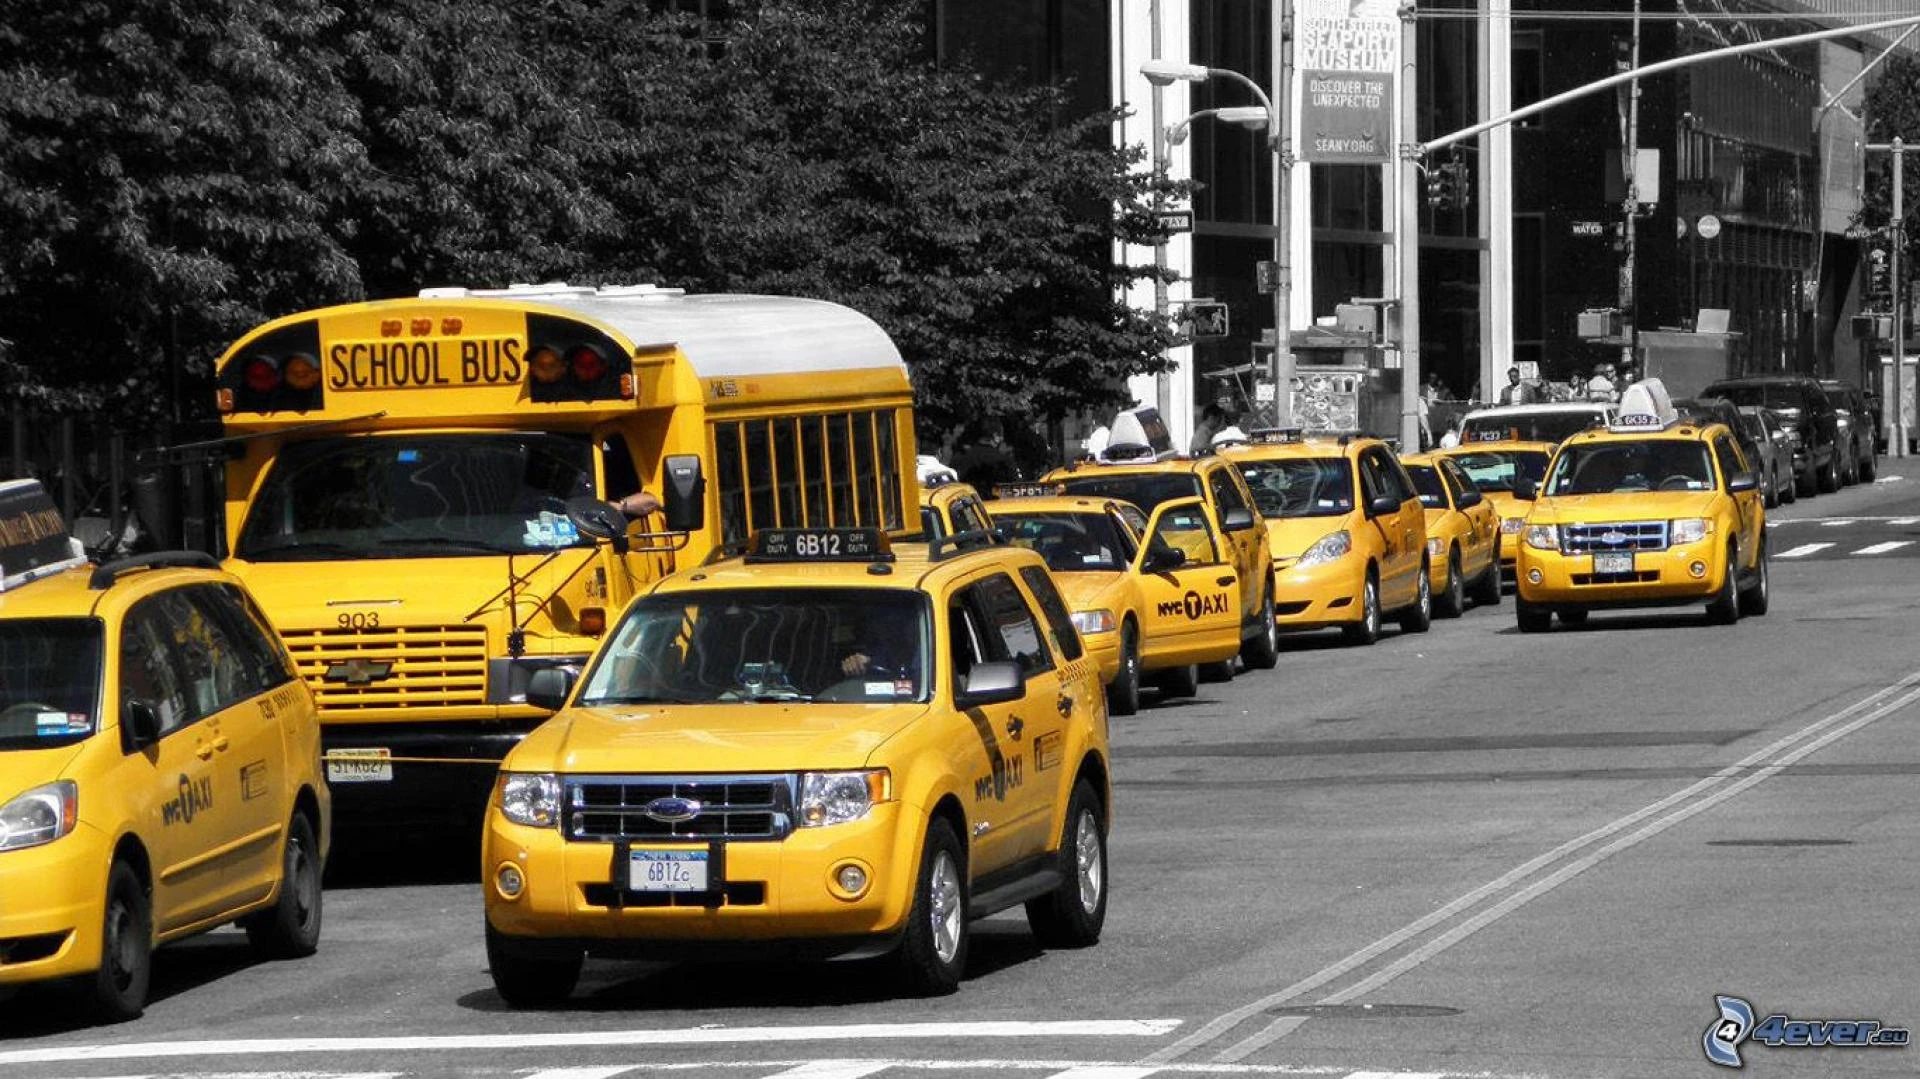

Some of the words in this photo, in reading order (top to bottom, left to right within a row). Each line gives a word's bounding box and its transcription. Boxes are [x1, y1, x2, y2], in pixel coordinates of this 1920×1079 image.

[1303, 30, 1395, 52] SEAPORT
[1303, 48, 1395, 72] MUSEUM
[1310, 80, 1361, 94] DISCOVER
[1364, 81, 1384, 96] THE
[1313, 93, 1380, 108] UNEXPECTED
[331, 341, 449, 387] SCHOOL
[461, 338, 521, 383] BUS
[769, 534, 785, 543] OFF
[796, 534, 840, 556] 6B12
[849, 533, 865, 542] OFF
[767, 544, 788, 553] DUTY
[847, 543, 869, 553] DUTY
[1157, 601, 1183, 617] NYC
[1184, 590, 1228, 620] TAXI
[337, 612, 379, 629] 903
[975, 774, 993, 802] NYC
